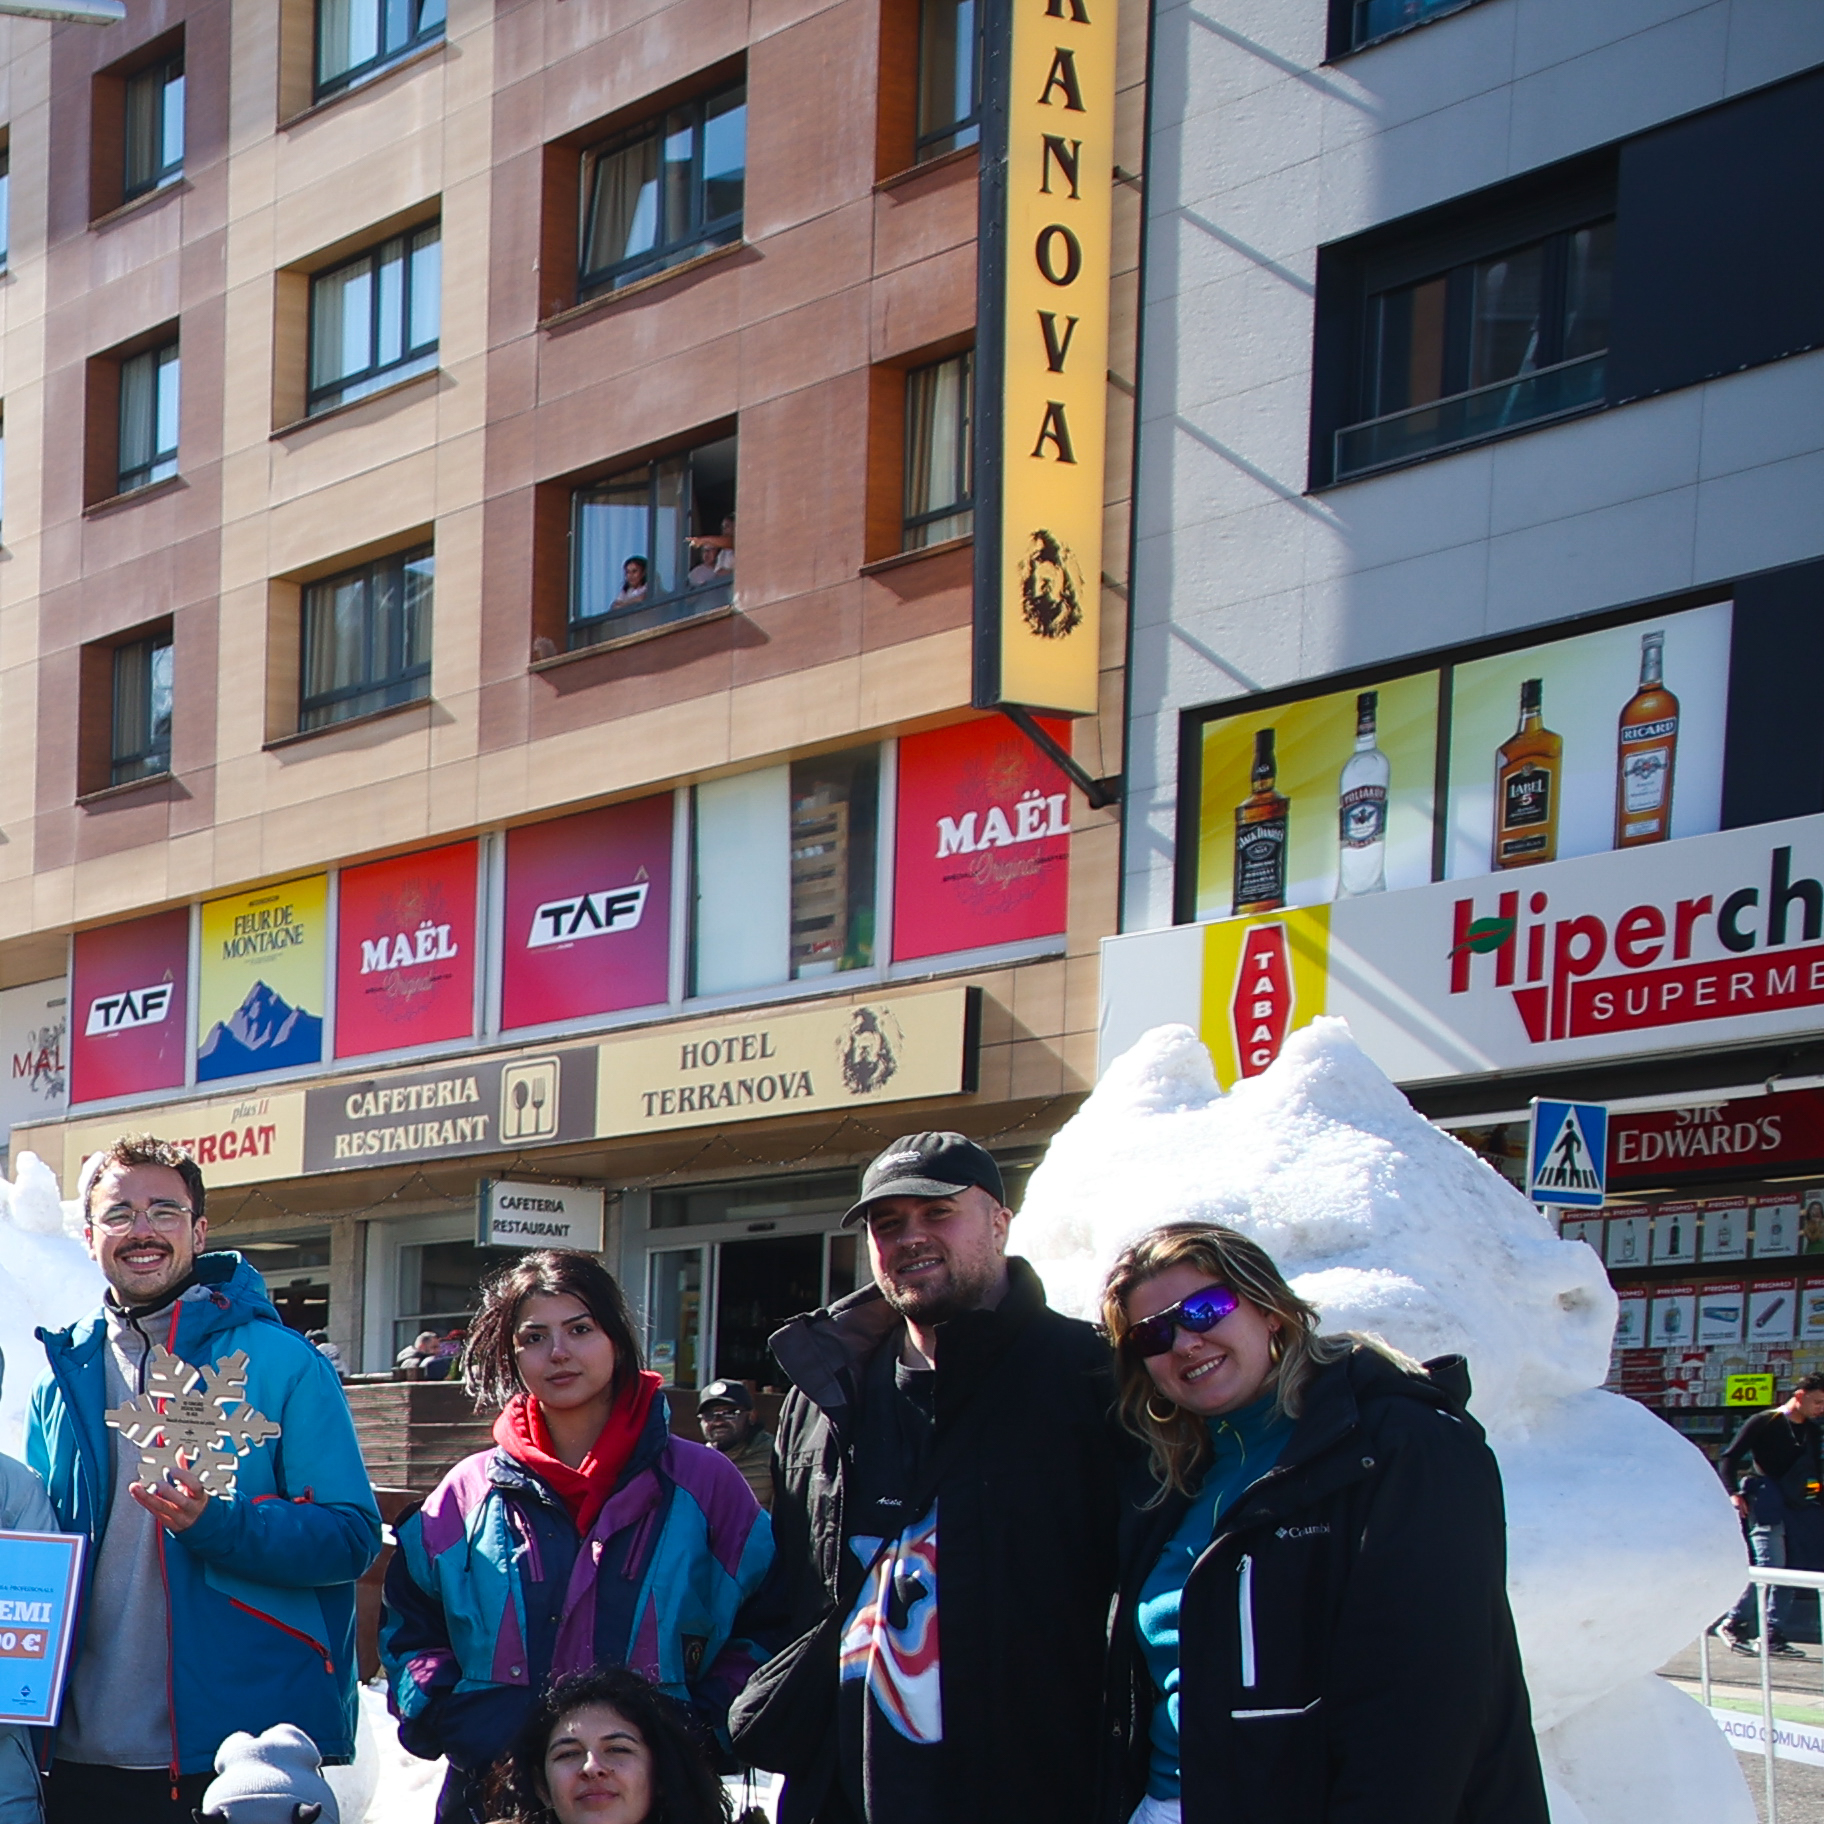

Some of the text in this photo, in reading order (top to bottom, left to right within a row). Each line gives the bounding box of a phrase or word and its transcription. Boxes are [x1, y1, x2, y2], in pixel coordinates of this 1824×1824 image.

[1624, 722, 1674, 739] RICARD
[1509, 779, 1546, 799] LABEL
[935, 788, 1071, 859] MAËL
[272, 904, 294, 926] DE
[540, 890, 641, 938] TAF
[222, 924, 304, 961] MONTAGNE
[360, 919, 458, 975] MAËL
[1448, 847, 1824, 1040] Hiperch
[95, 989, 167, 1027] TAF
[1250, 951, 1276, 1067] TABAC
[1592, 960, 1824, 1020] SUPERME
[12, 1045, 65, 1079] MAL
[679, 1031, 776, 1071] HOTEL
[346, 1076, 480, 1120] CAFETERIA
[641, 1070, 816, 1119] TERRANOVA
[334, 1115, 490, 1159] RESTAURANT
[1616, 1115, 1782, 1165] EDWARD'S
[499, 1194, 565, 1214] CAFETERIA
[493, 1218, 571, 1238] RESTAURANT
[21, 1633, 41, 1652] €
